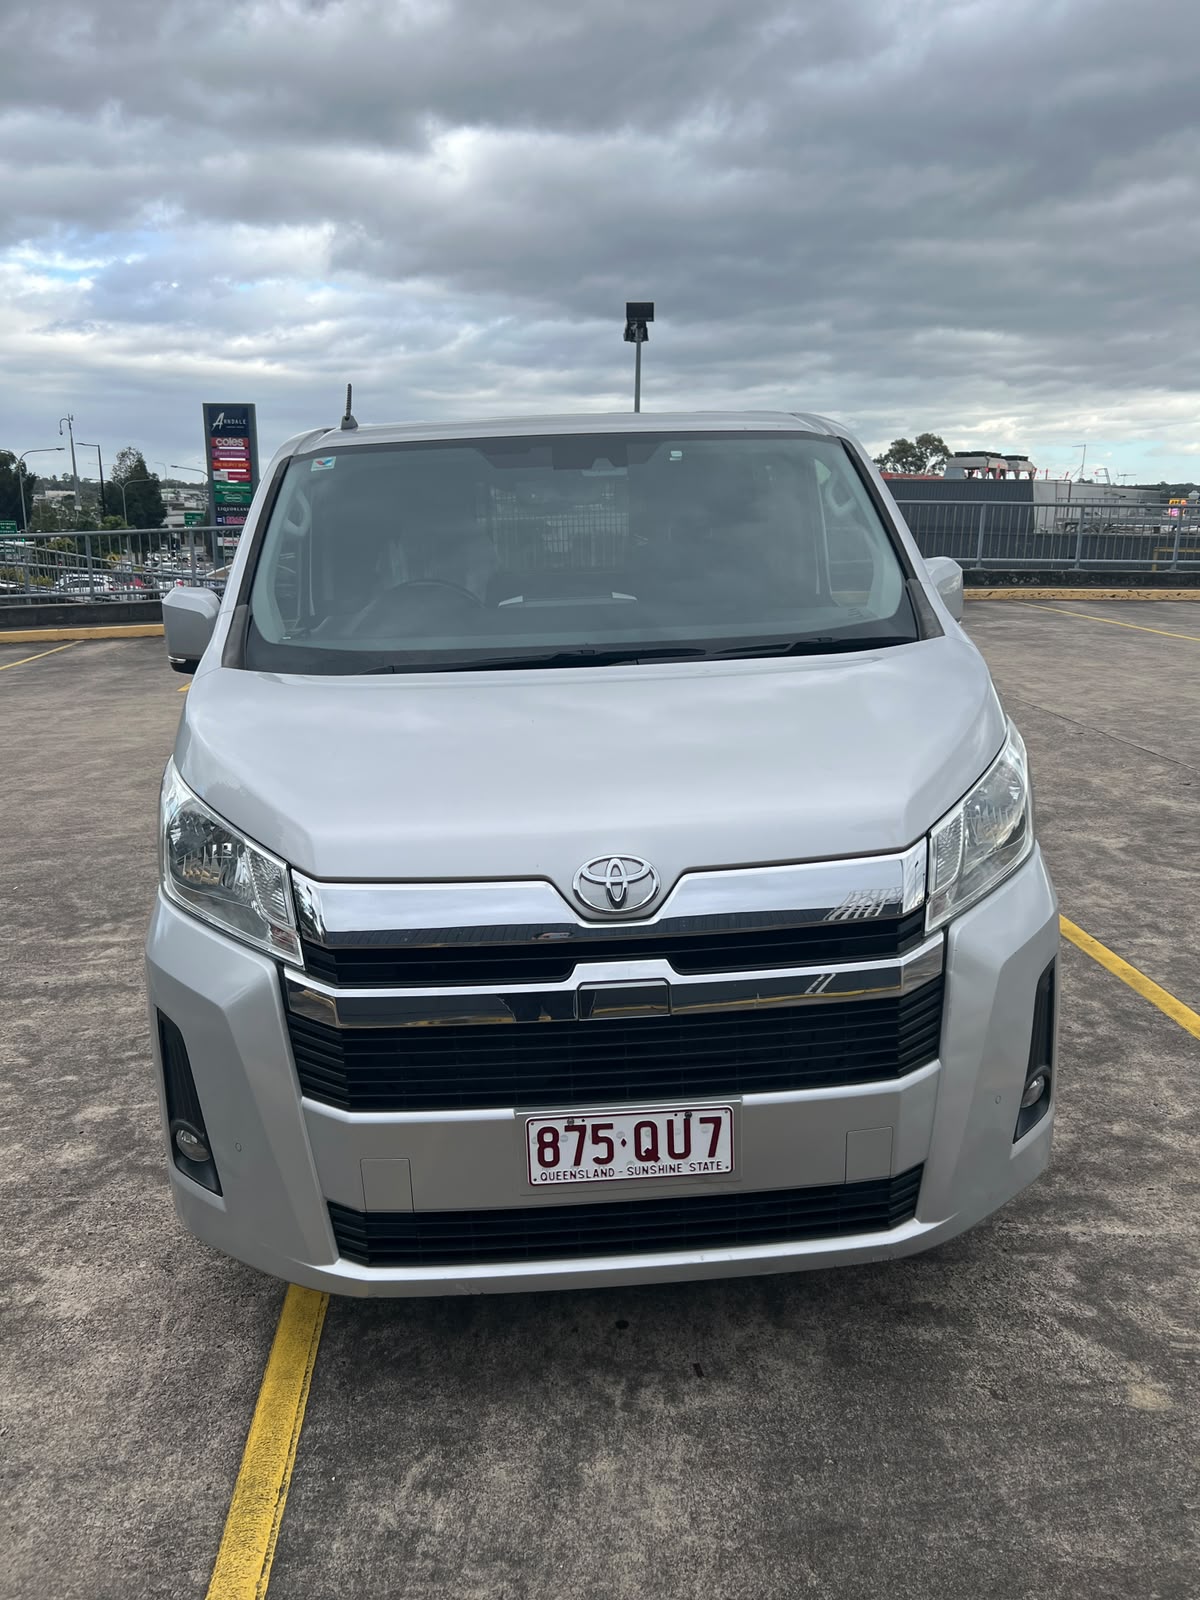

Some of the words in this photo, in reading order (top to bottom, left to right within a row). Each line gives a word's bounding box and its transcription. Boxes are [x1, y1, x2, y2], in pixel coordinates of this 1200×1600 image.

[211, 412, 246, 431] ARNDALE
[215, 437, 244, 447] coles
[540, 1167, 615, 1181] QUEENSLAND
[627, 1163, 683, 1176] SUNSHINE
[689, 1161, 722, 1172] STATE
